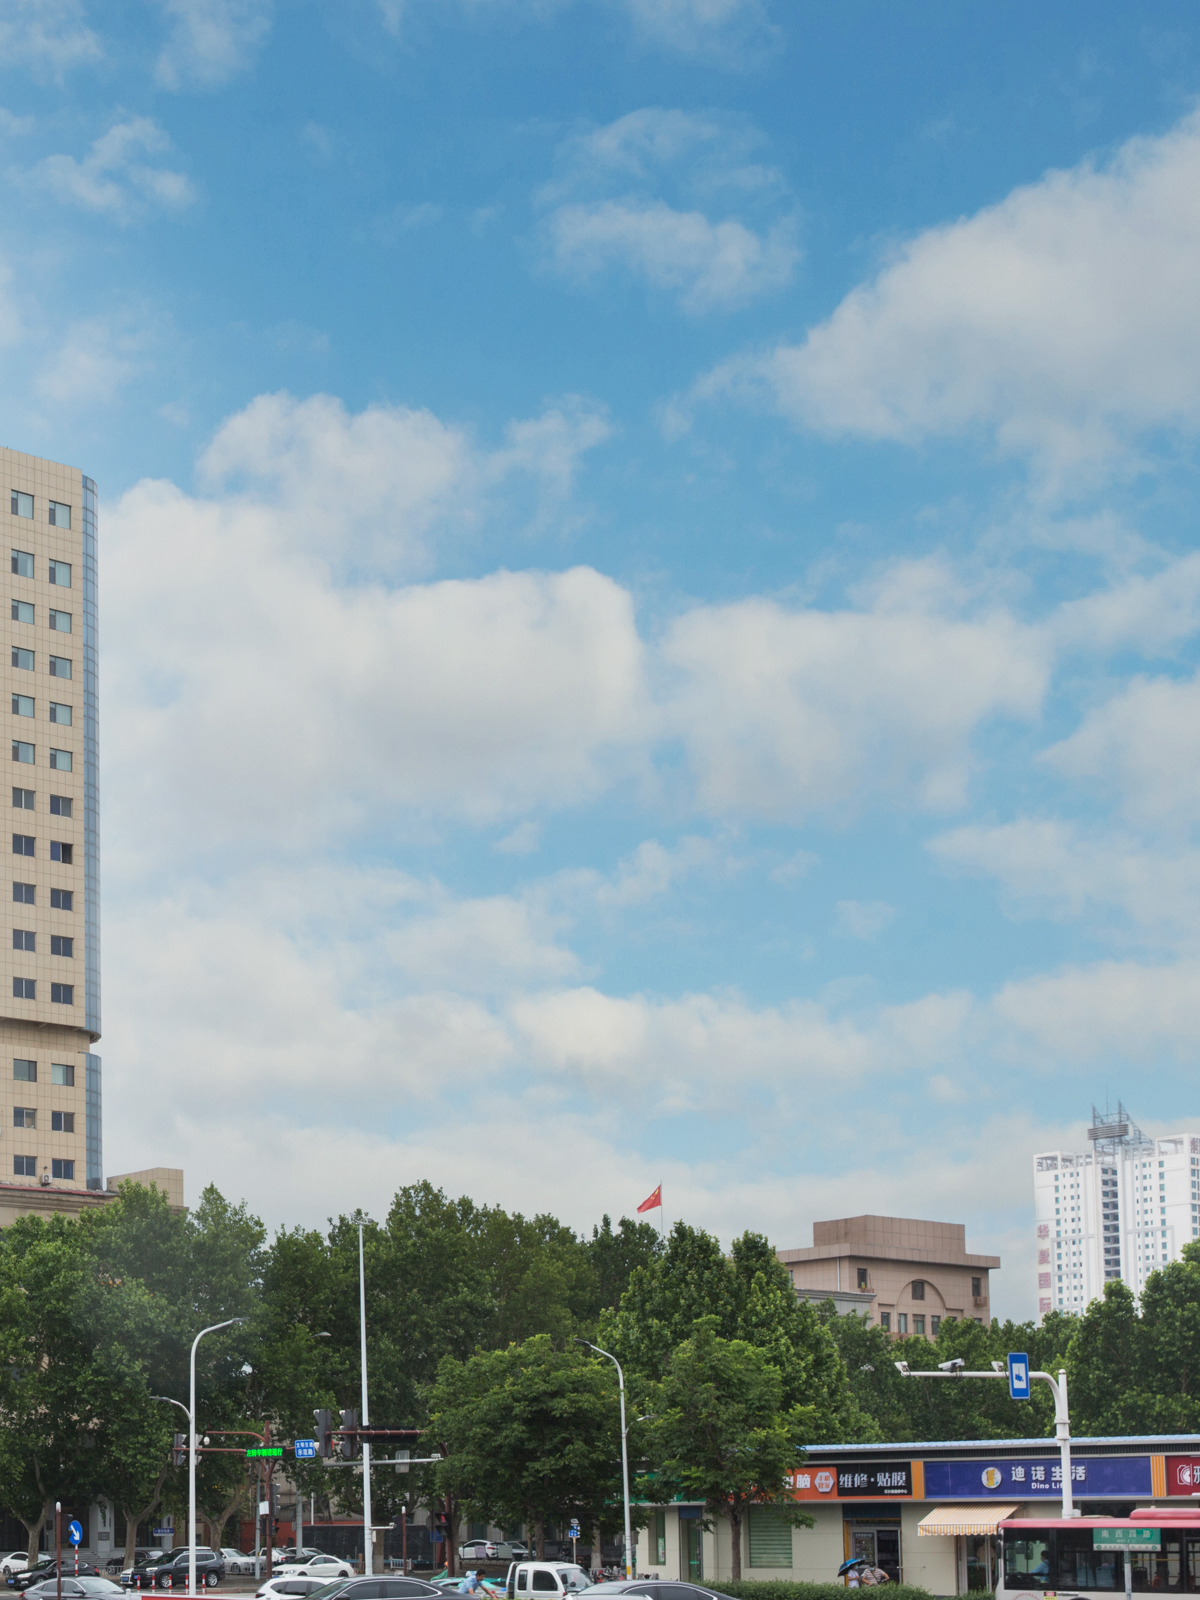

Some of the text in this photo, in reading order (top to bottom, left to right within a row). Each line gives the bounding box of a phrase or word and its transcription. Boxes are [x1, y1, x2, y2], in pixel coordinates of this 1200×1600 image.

[1037, 1224, 1052, 1314] 华夏国际
[1011, 1466, 1086, 1481] 迪诺生活
[1102, 1529, 1151, 1539] 南西四路
